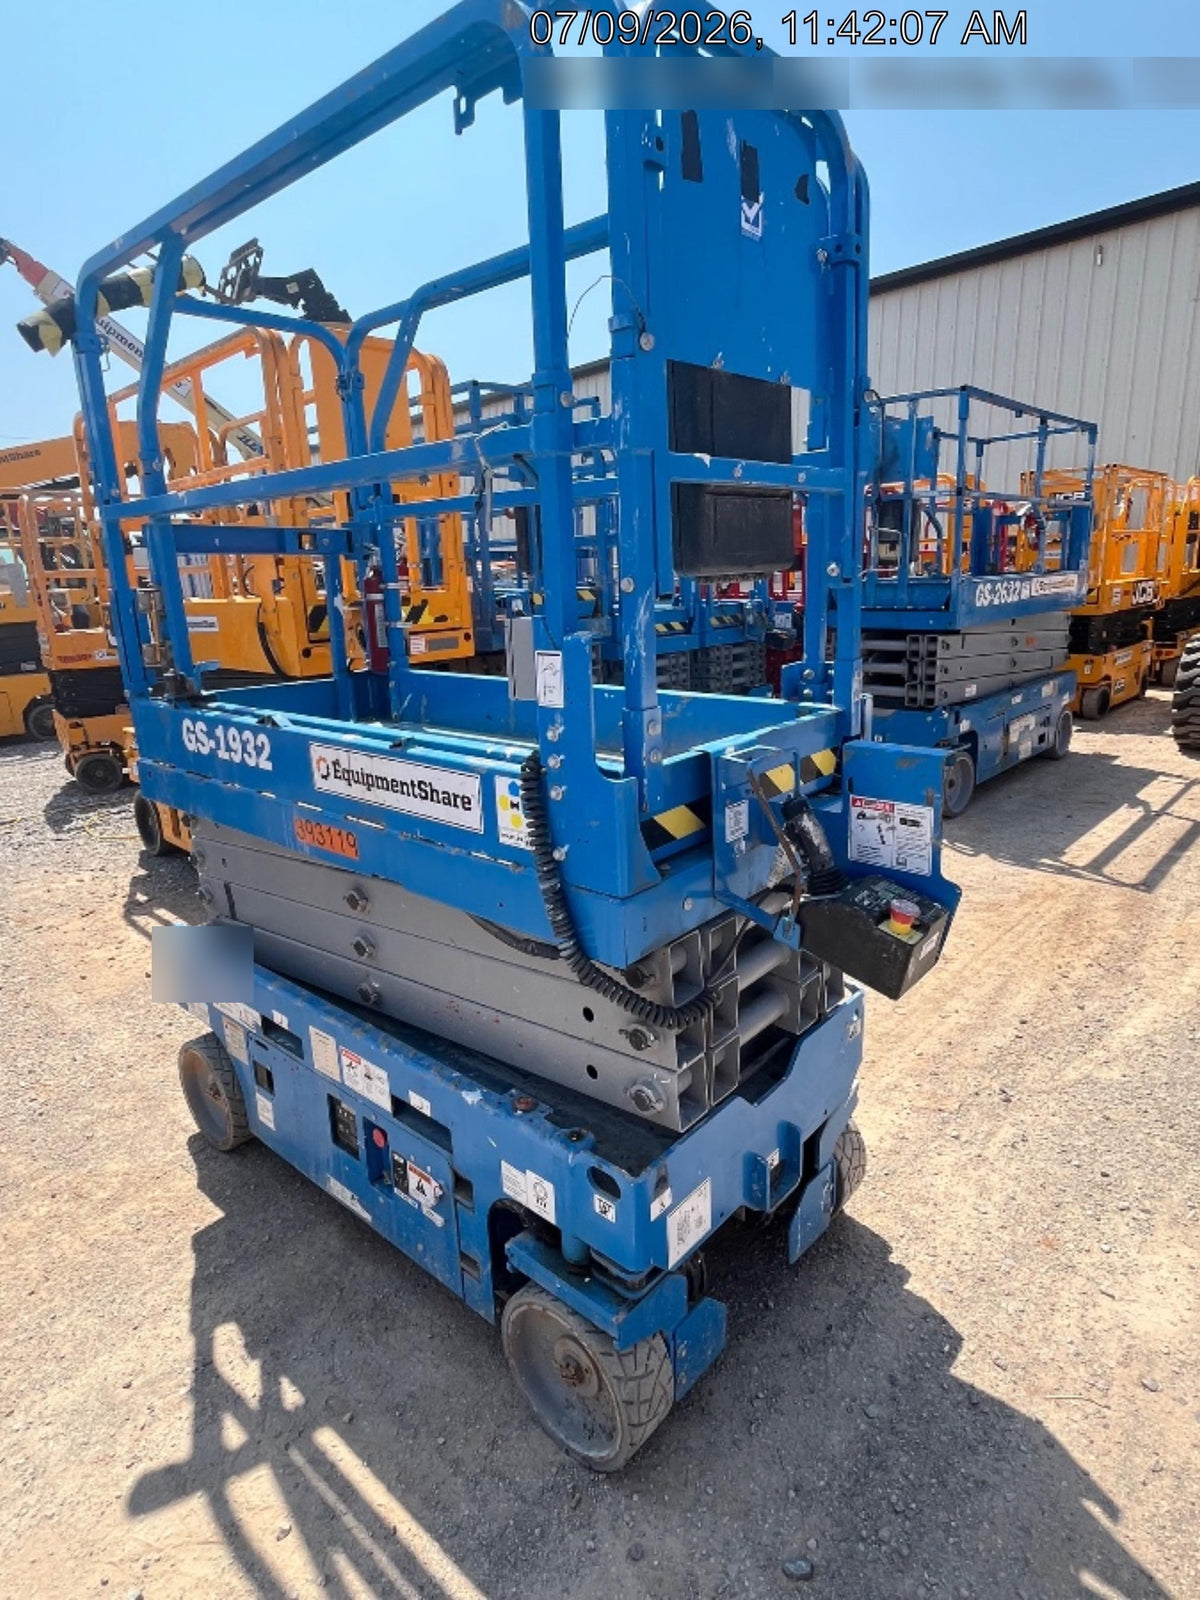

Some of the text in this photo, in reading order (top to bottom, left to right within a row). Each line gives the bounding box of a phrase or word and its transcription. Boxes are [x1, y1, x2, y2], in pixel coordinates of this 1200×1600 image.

[975, 580, 1020, 607] GS-2632
[182, 718, 273, 771] GS-1932
[332, 758, 472, 811] EquipmentShare
